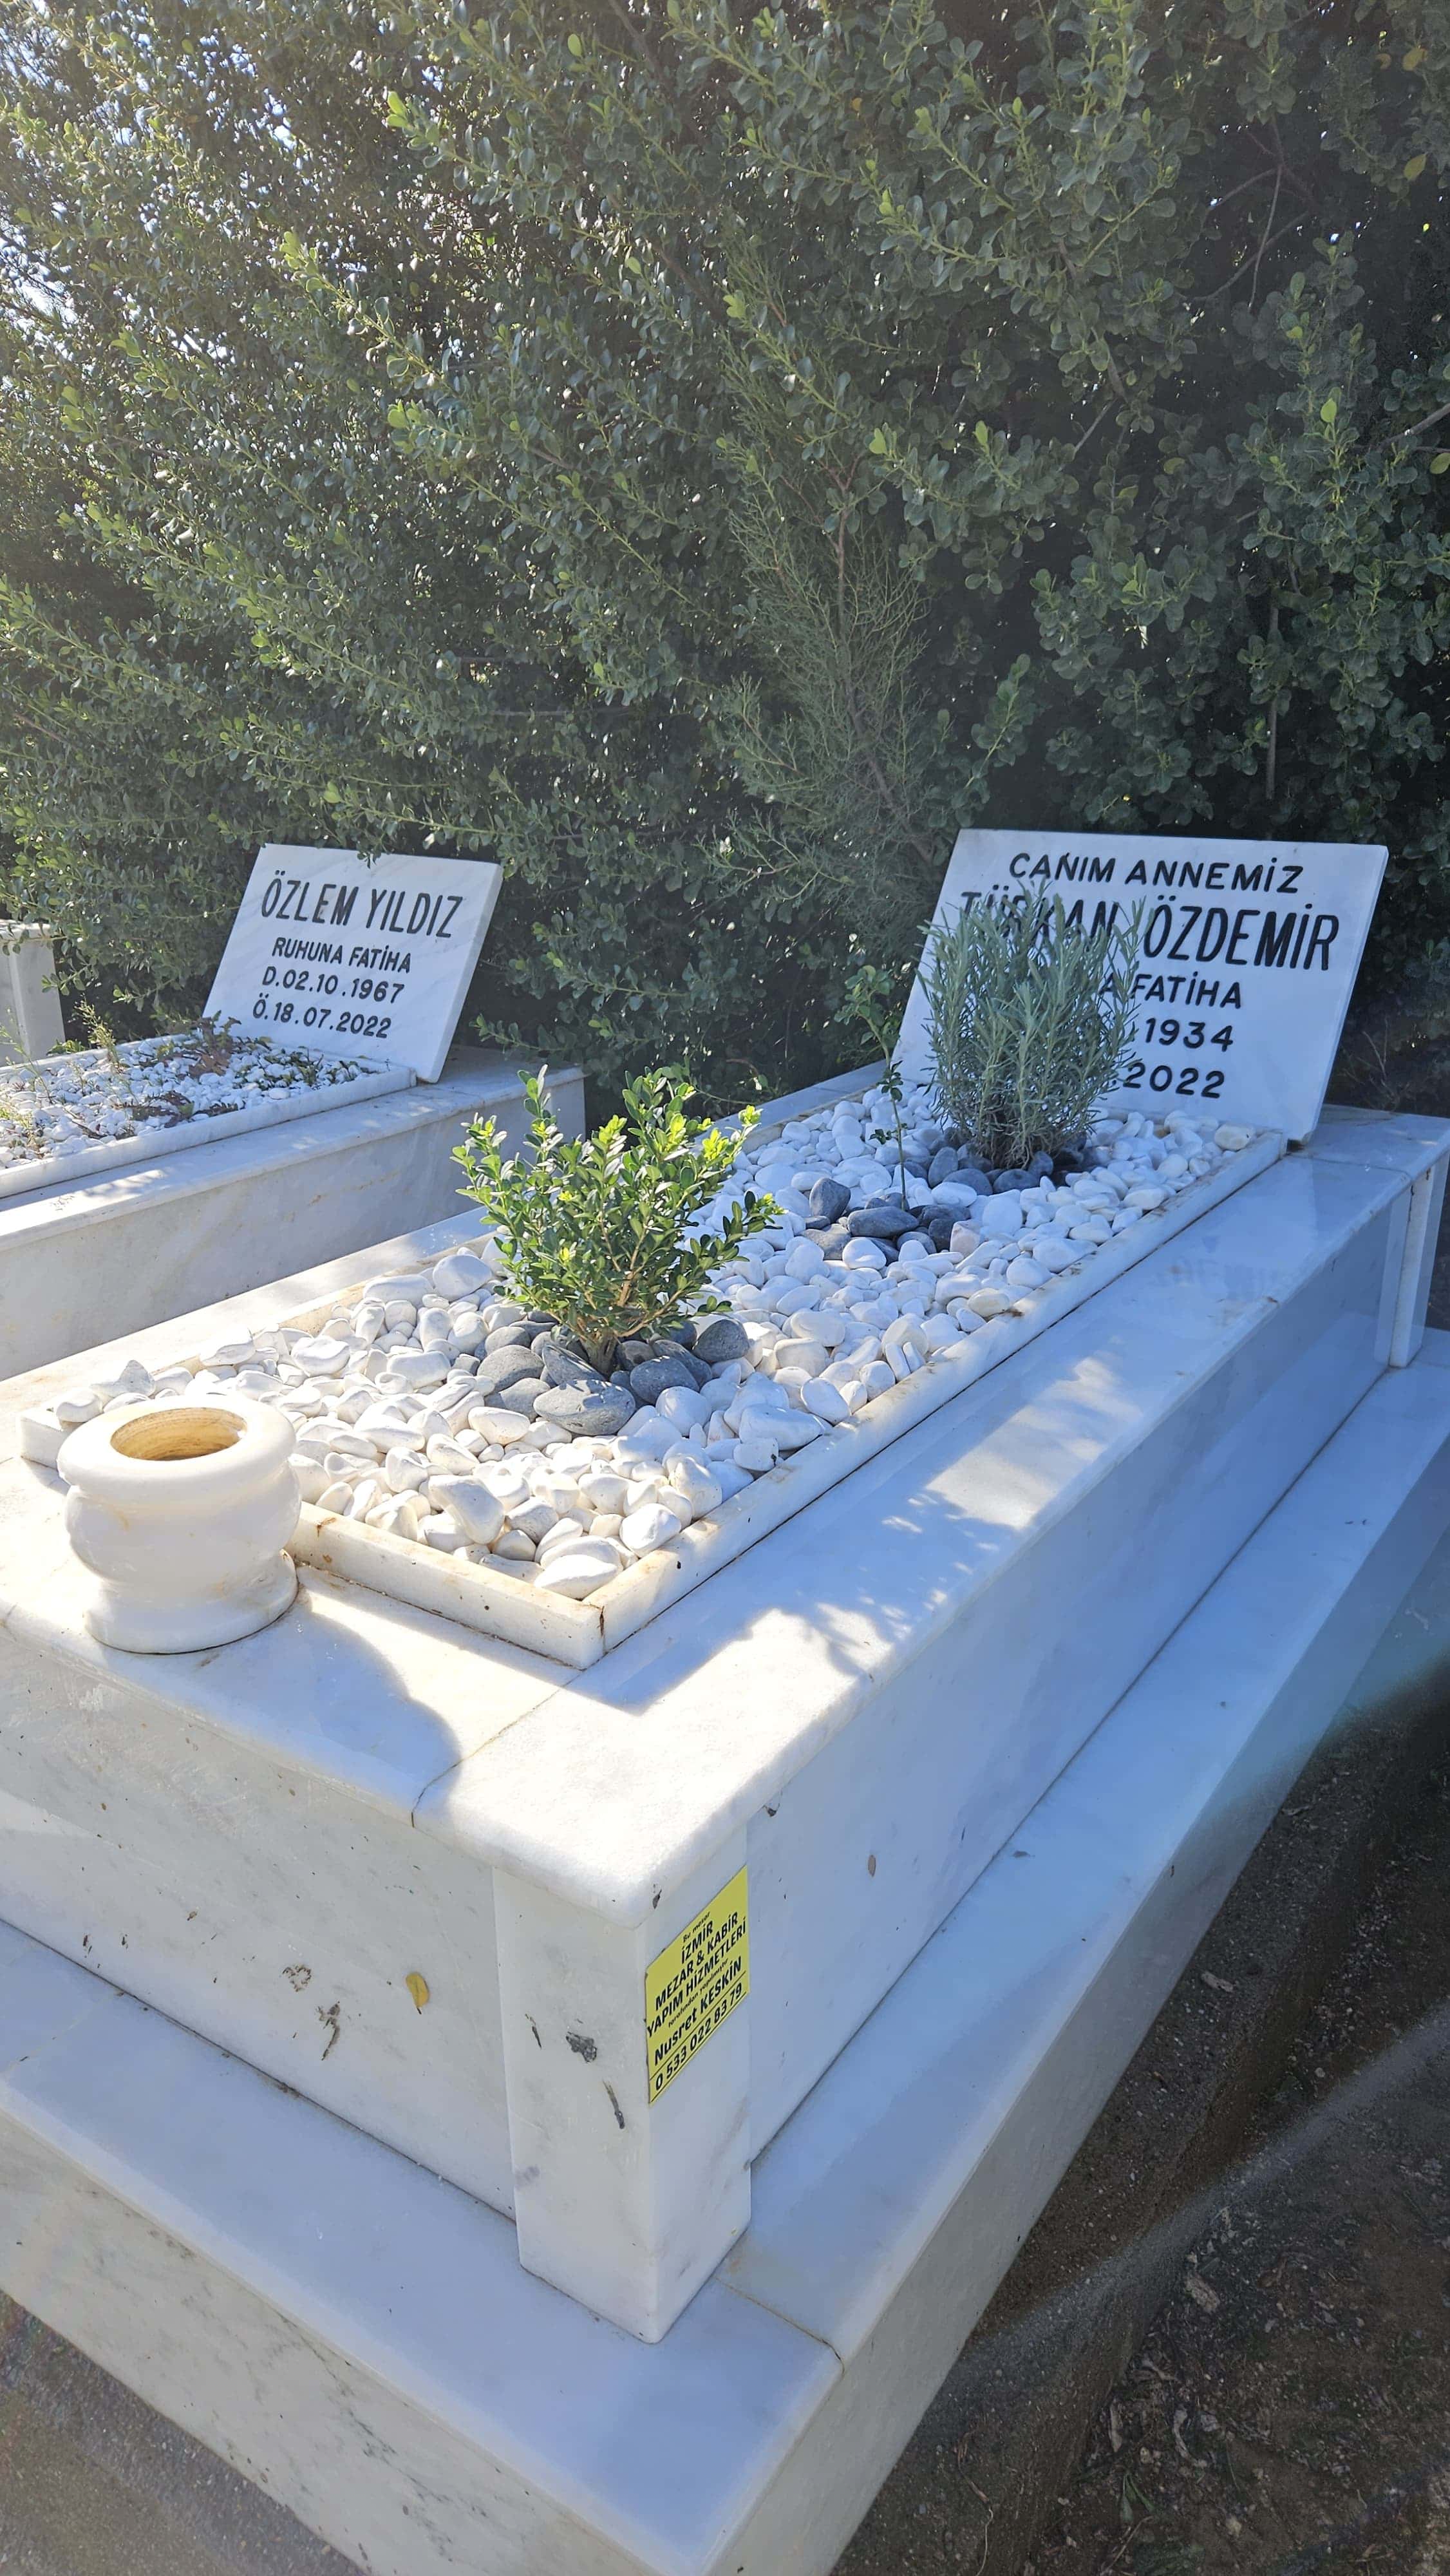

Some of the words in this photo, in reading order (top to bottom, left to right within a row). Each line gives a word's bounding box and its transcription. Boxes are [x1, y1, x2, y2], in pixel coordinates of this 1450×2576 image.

[261, 869, 359, 926] ÖZLEM
[365, 889, 463, 938] YILDIZ
[1009, 852, 1116, 884] CANIM
[1124, 857, 1304, 895] ANNEMİZ
[271, 936, 343, 965] RUHUNA
[348, 944, 411, 973] FATİHA
[1143, 895, 1340, 971] ÖZDEMİR
[1129, 971, 1242, 1009] FATİHA
[646, 1989, 683, 2038] YAPIM
[686, 1916, 746, 1997] HİZMETLERİ
[655, 1960, 694, 2011] MEZAR
[696, 1949, 705, 1966] &
[707, 1911, 738, 1955] KABİR
[681, 1920, 713, 1964] İZMİR
[654, 2007, 697, 2067] Nusret
[700, 1956, 742, 2015] KESKİN
[655, 2072, 663, 2090] 0
[666, 2045, 687, 2079] 533
[690, 2018, 711, 2052] 022
[714, 1999, 728, 2024] 83
[730, 1982, 742, 2007] 79
